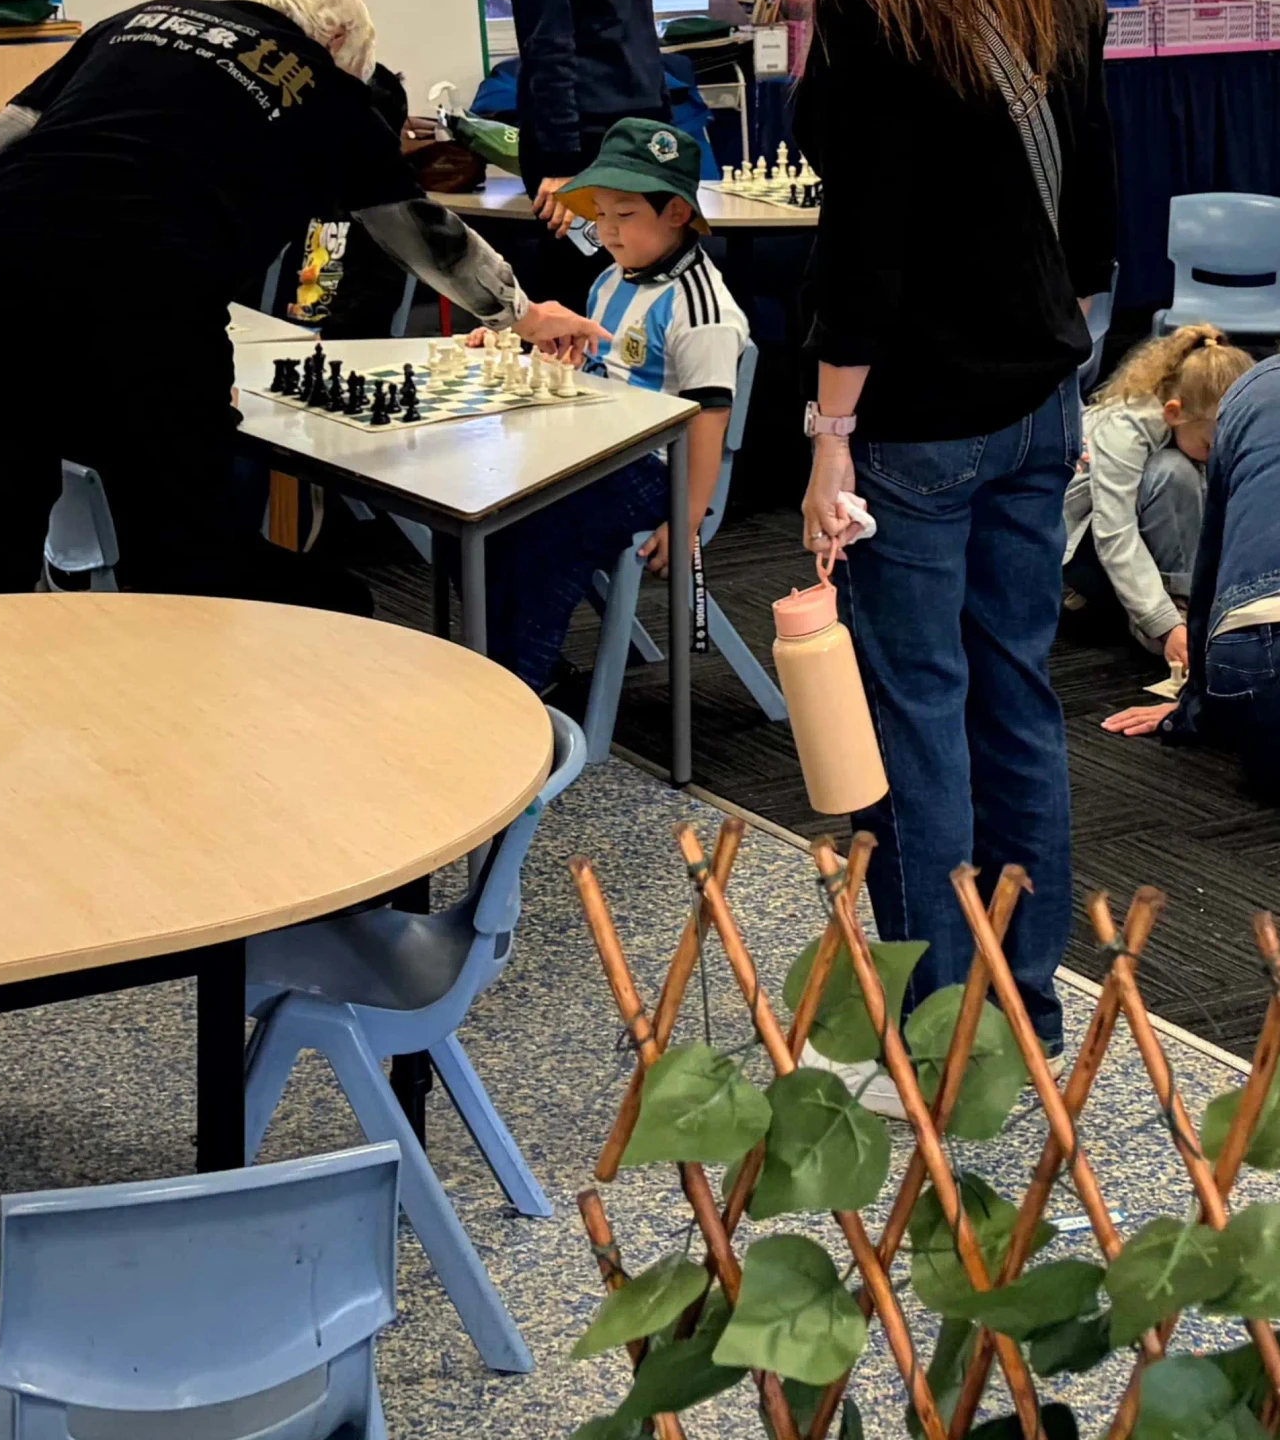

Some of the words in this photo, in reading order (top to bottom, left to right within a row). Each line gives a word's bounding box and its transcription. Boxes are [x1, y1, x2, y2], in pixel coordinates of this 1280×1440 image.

[109, 32, 169, 46] Everything
[195, 47, 216, 59] our
[695, 572, 704, 586] OF
